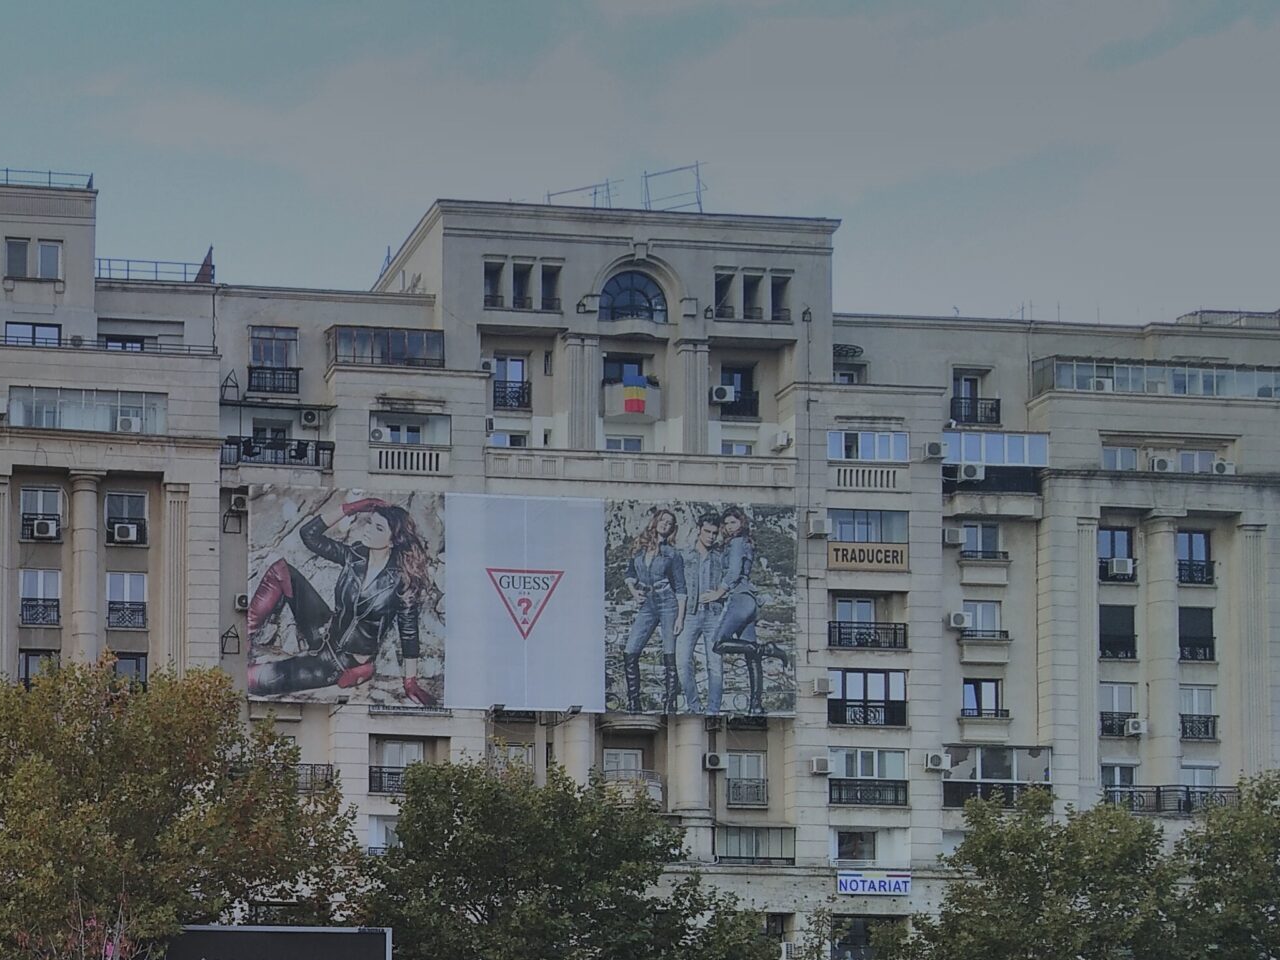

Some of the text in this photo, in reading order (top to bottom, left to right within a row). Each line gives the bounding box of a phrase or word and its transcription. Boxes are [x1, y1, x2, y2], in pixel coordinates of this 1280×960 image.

[833, 548, 904, 564] TRADUCERI
[499, 575, 550, 590] GUESS
[839, 879, 910, 892] NOTARIAT
